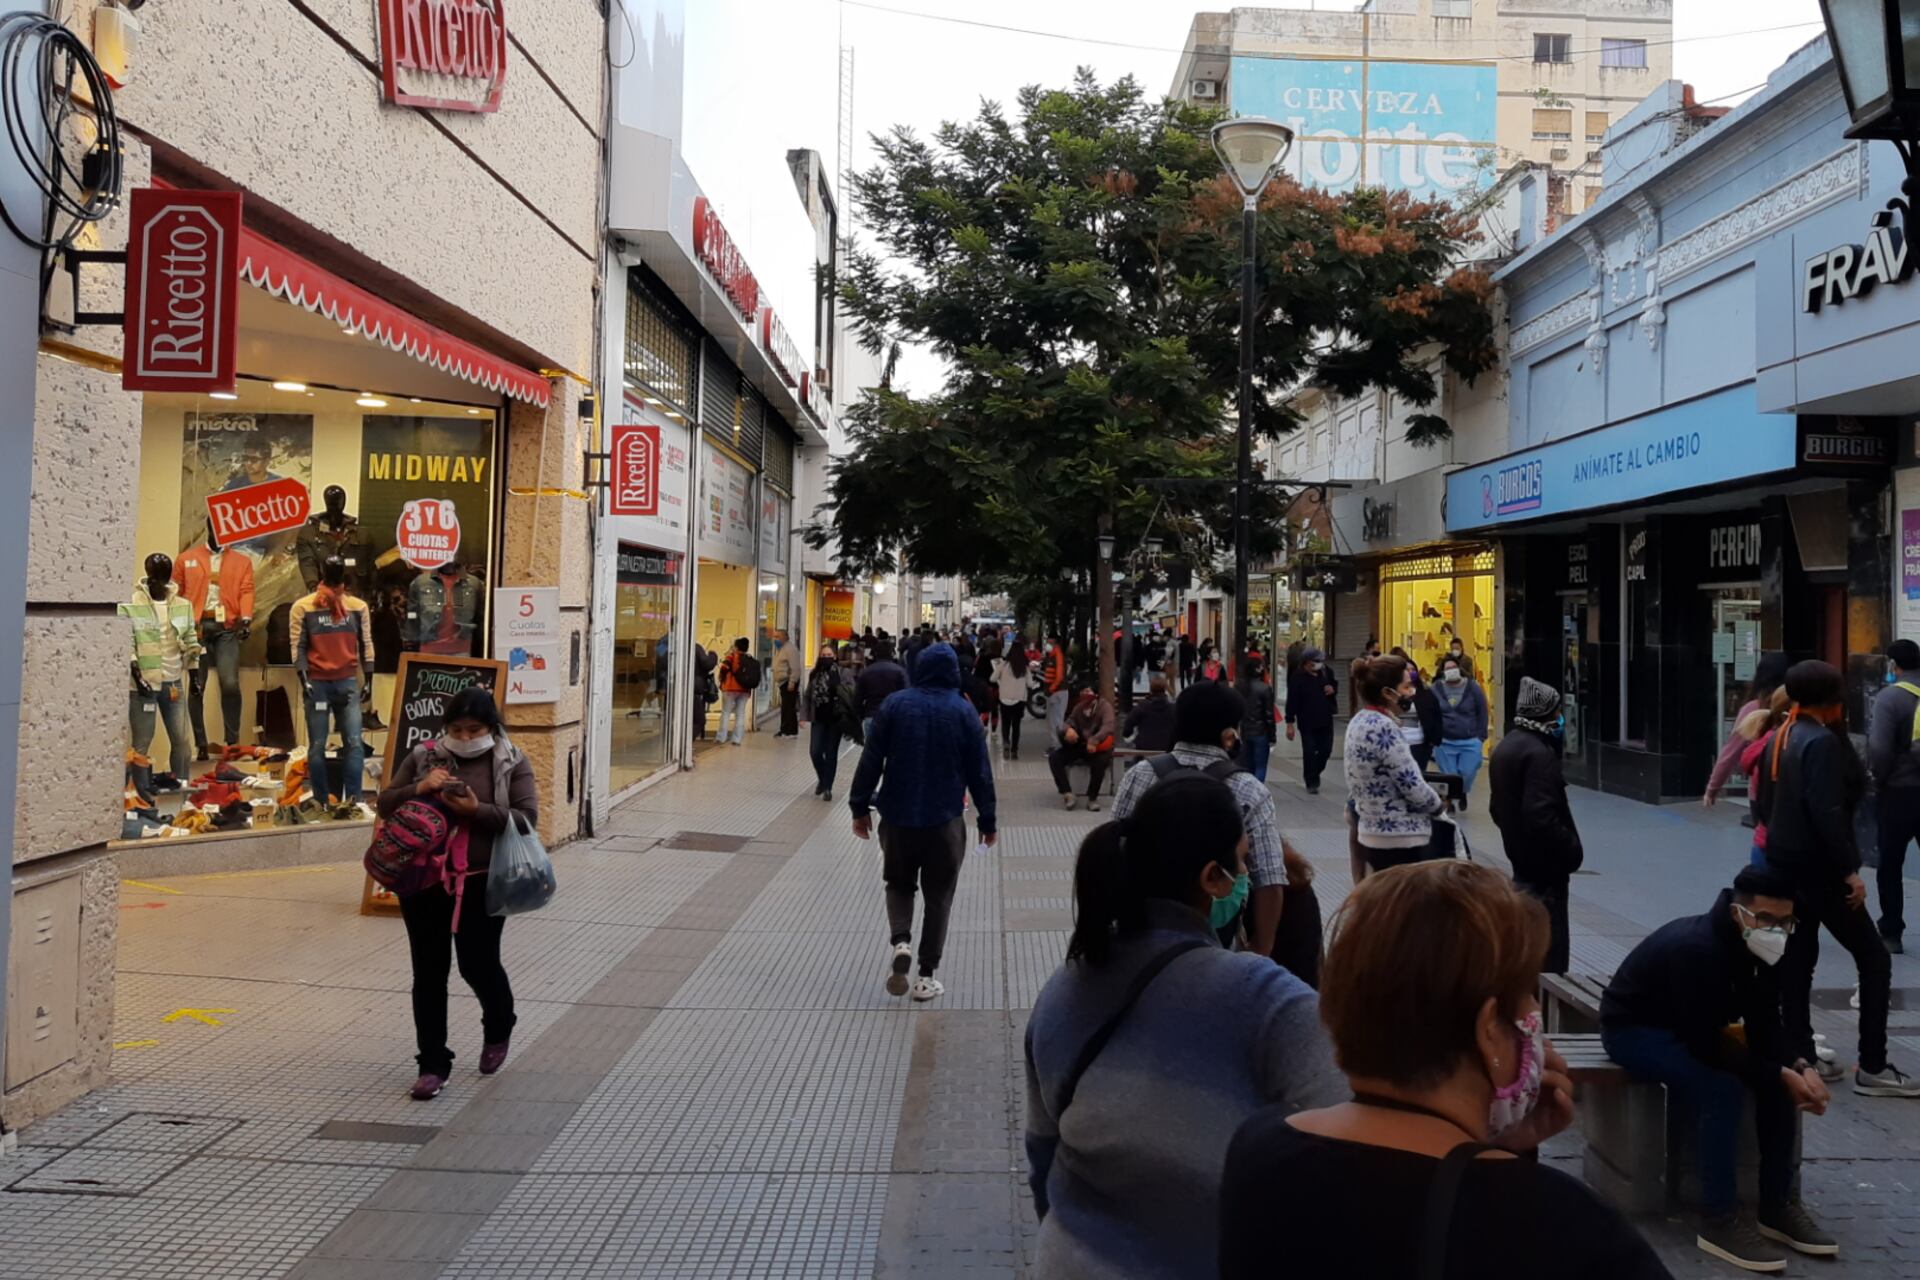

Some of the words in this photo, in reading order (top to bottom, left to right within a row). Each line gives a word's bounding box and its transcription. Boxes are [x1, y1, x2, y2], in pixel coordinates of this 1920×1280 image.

[1283, 87, 1443, 115] CERVEZA
[150, 225, 207, 366] Ricetto
[187, 417, 259, 431] mistral
[368, 453, 486, 483] MIDWAY
[622, 440, 646, 503] Ricetto
[1573, 452, 1623, 483] ANÍMATE
[1627, 447, 1642, 472] AL
[1646, 432, 1700, 466] CAMBIO
[1498, 460, 1542, 504] BURGOS
[212, 492, 301, 537] Ricetto
[403, 500, 422, 532] 3
[424, 506, 435, 526] Y
[439, 499, 456, 530] 6
[400, 547, 418, 560] SIN
[408, 533, 449, 549] CUOTAS
[519, 594, 534, 617] 5
[508, 620, 545, 630] Cuotas
[405, 697, 444, 720] BOTAS
